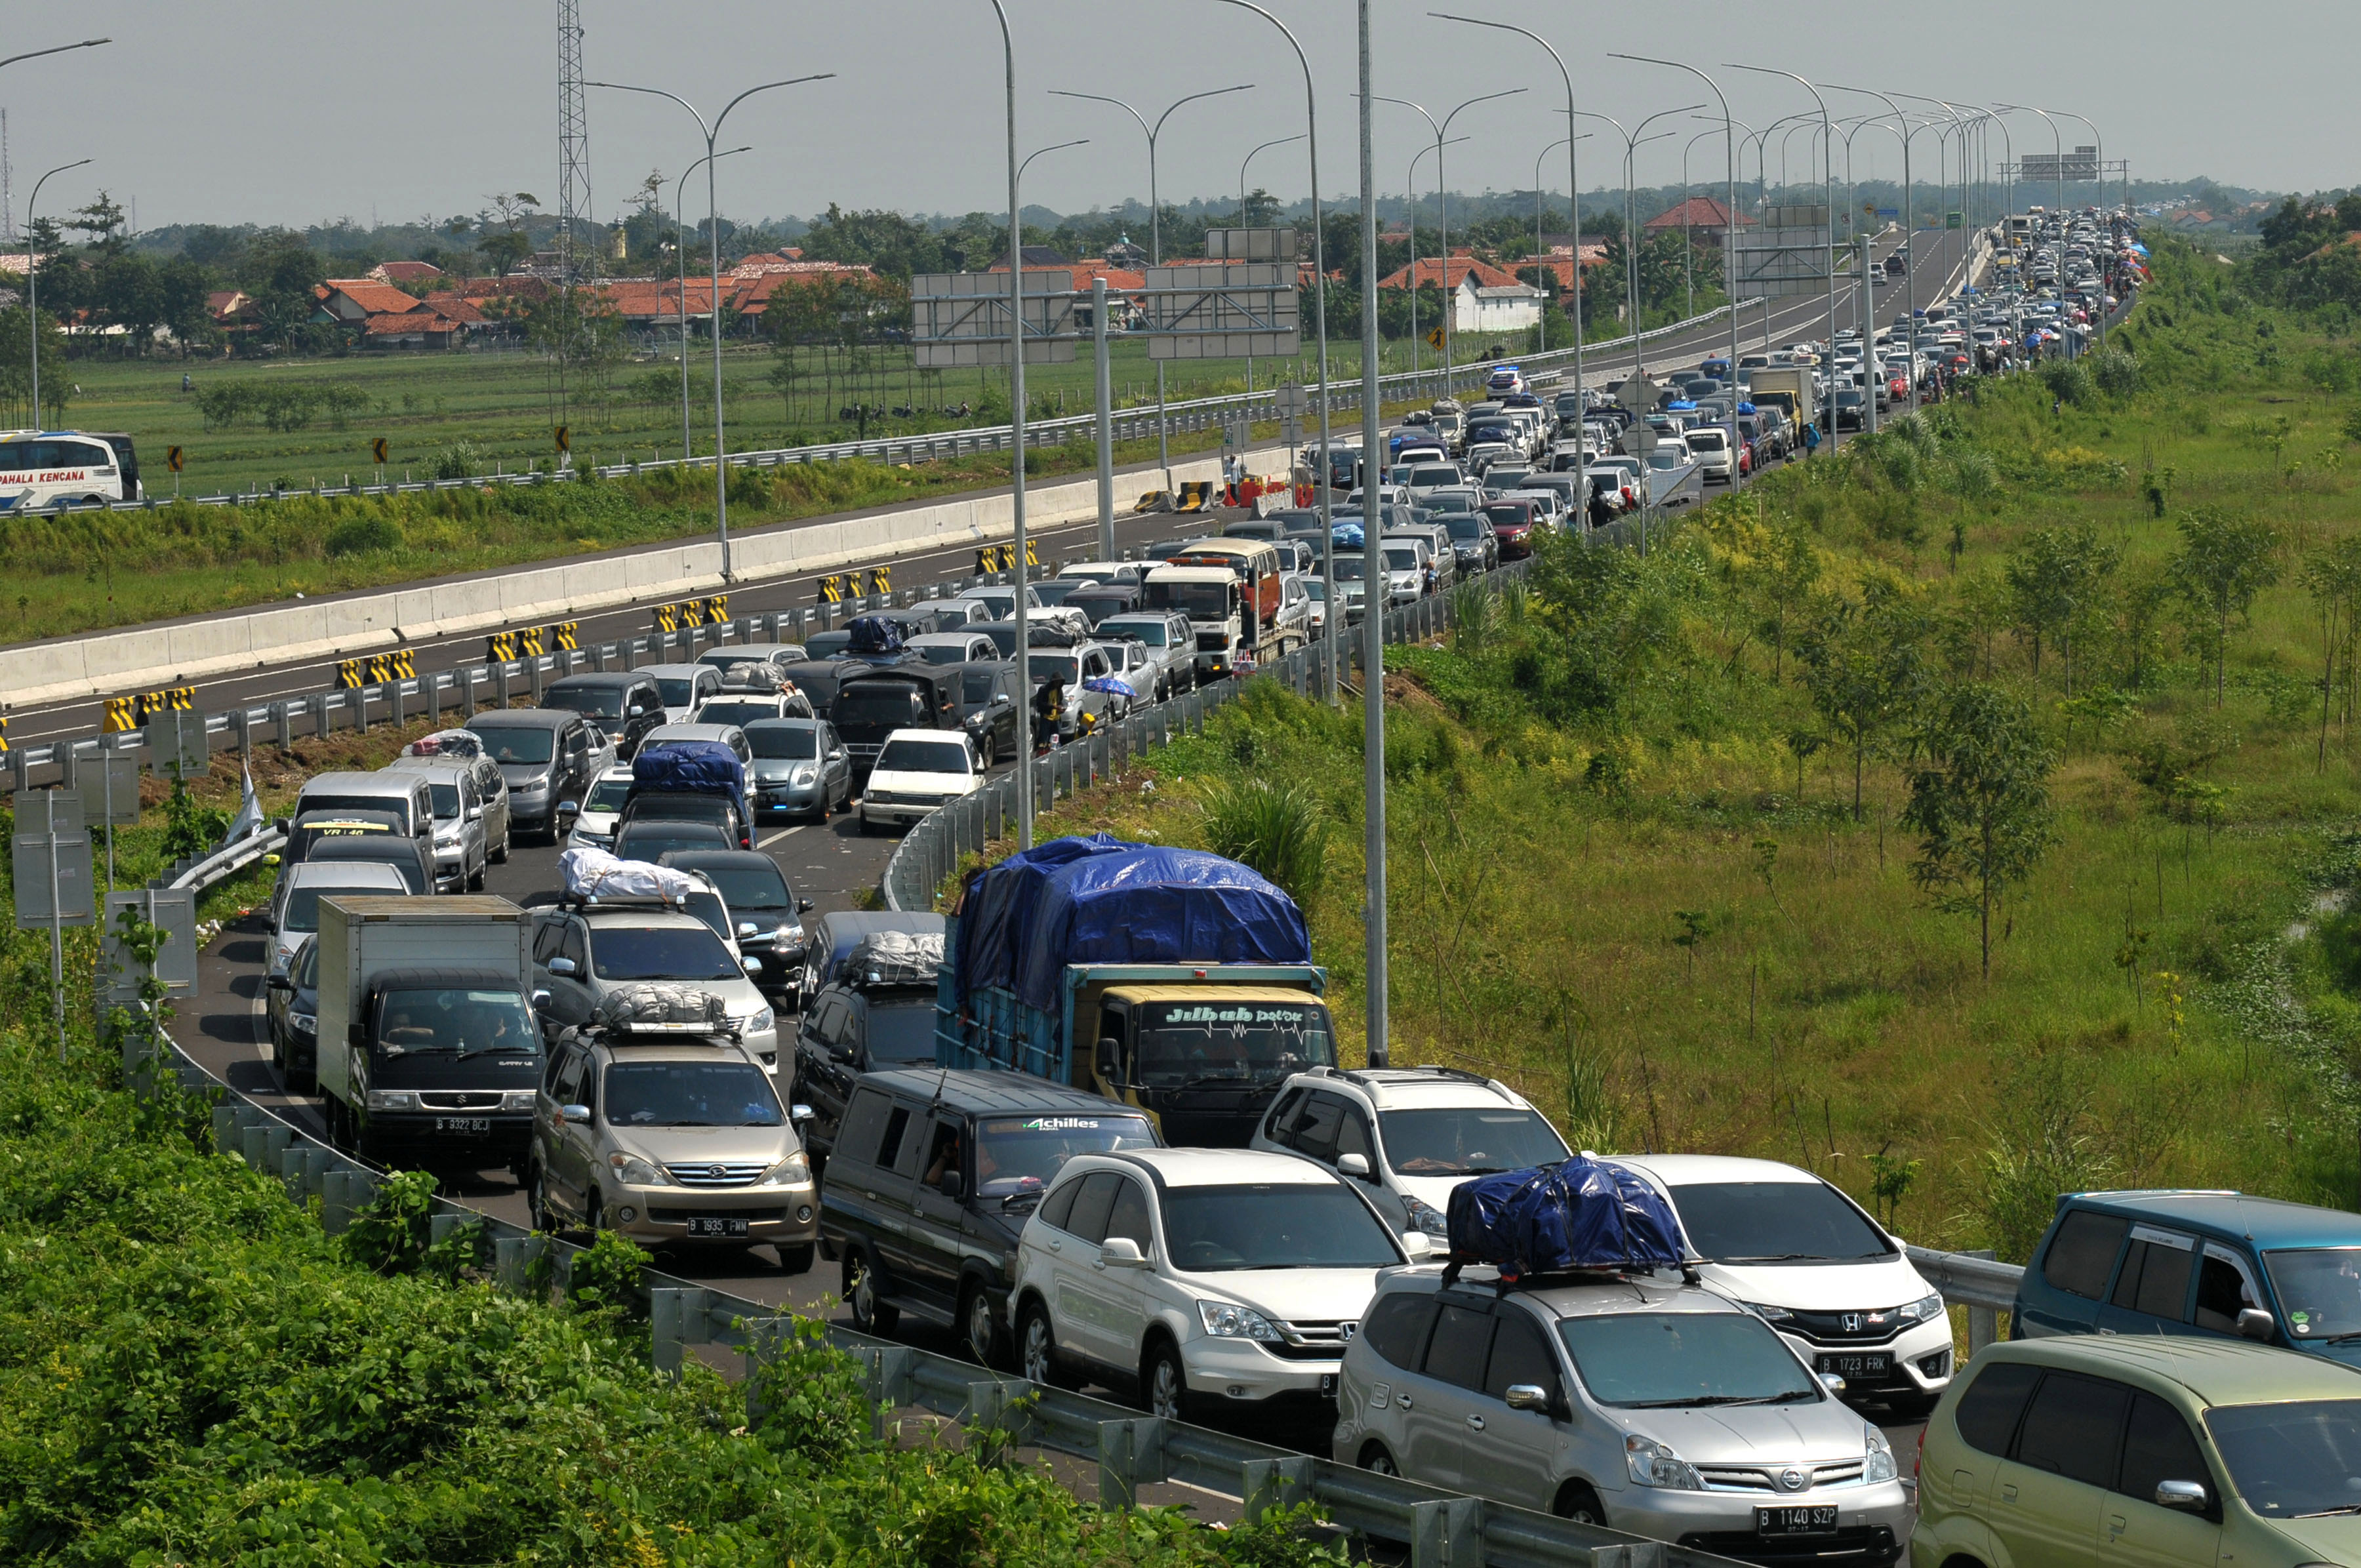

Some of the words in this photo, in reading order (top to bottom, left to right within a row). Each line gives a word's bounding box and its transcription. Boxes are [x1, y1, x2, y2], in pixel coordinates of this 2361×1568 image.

[39, 471, 85, 483] KENCANA
[437, 1119, 443, 1129] B
[450, 1119, 470, 1129] 9322
[1026, 1117, 1099, 1129] Achilles
[690, 1220, 696, 1230] B
[703, 1220, 723, 1231] 1935
[1824, 1359, 1830, 1371] B
[1840, 1357, 1861, 1371] 1723
[1867, 1357, 1885, 1370] FRK
[1323, 1375, 1330, 1388] B
[1762, 1510, 1769, 1526] B
[1781, 1509, 1808, 1525] 1140
[1813, 1508, 1835, 1523] SZP
